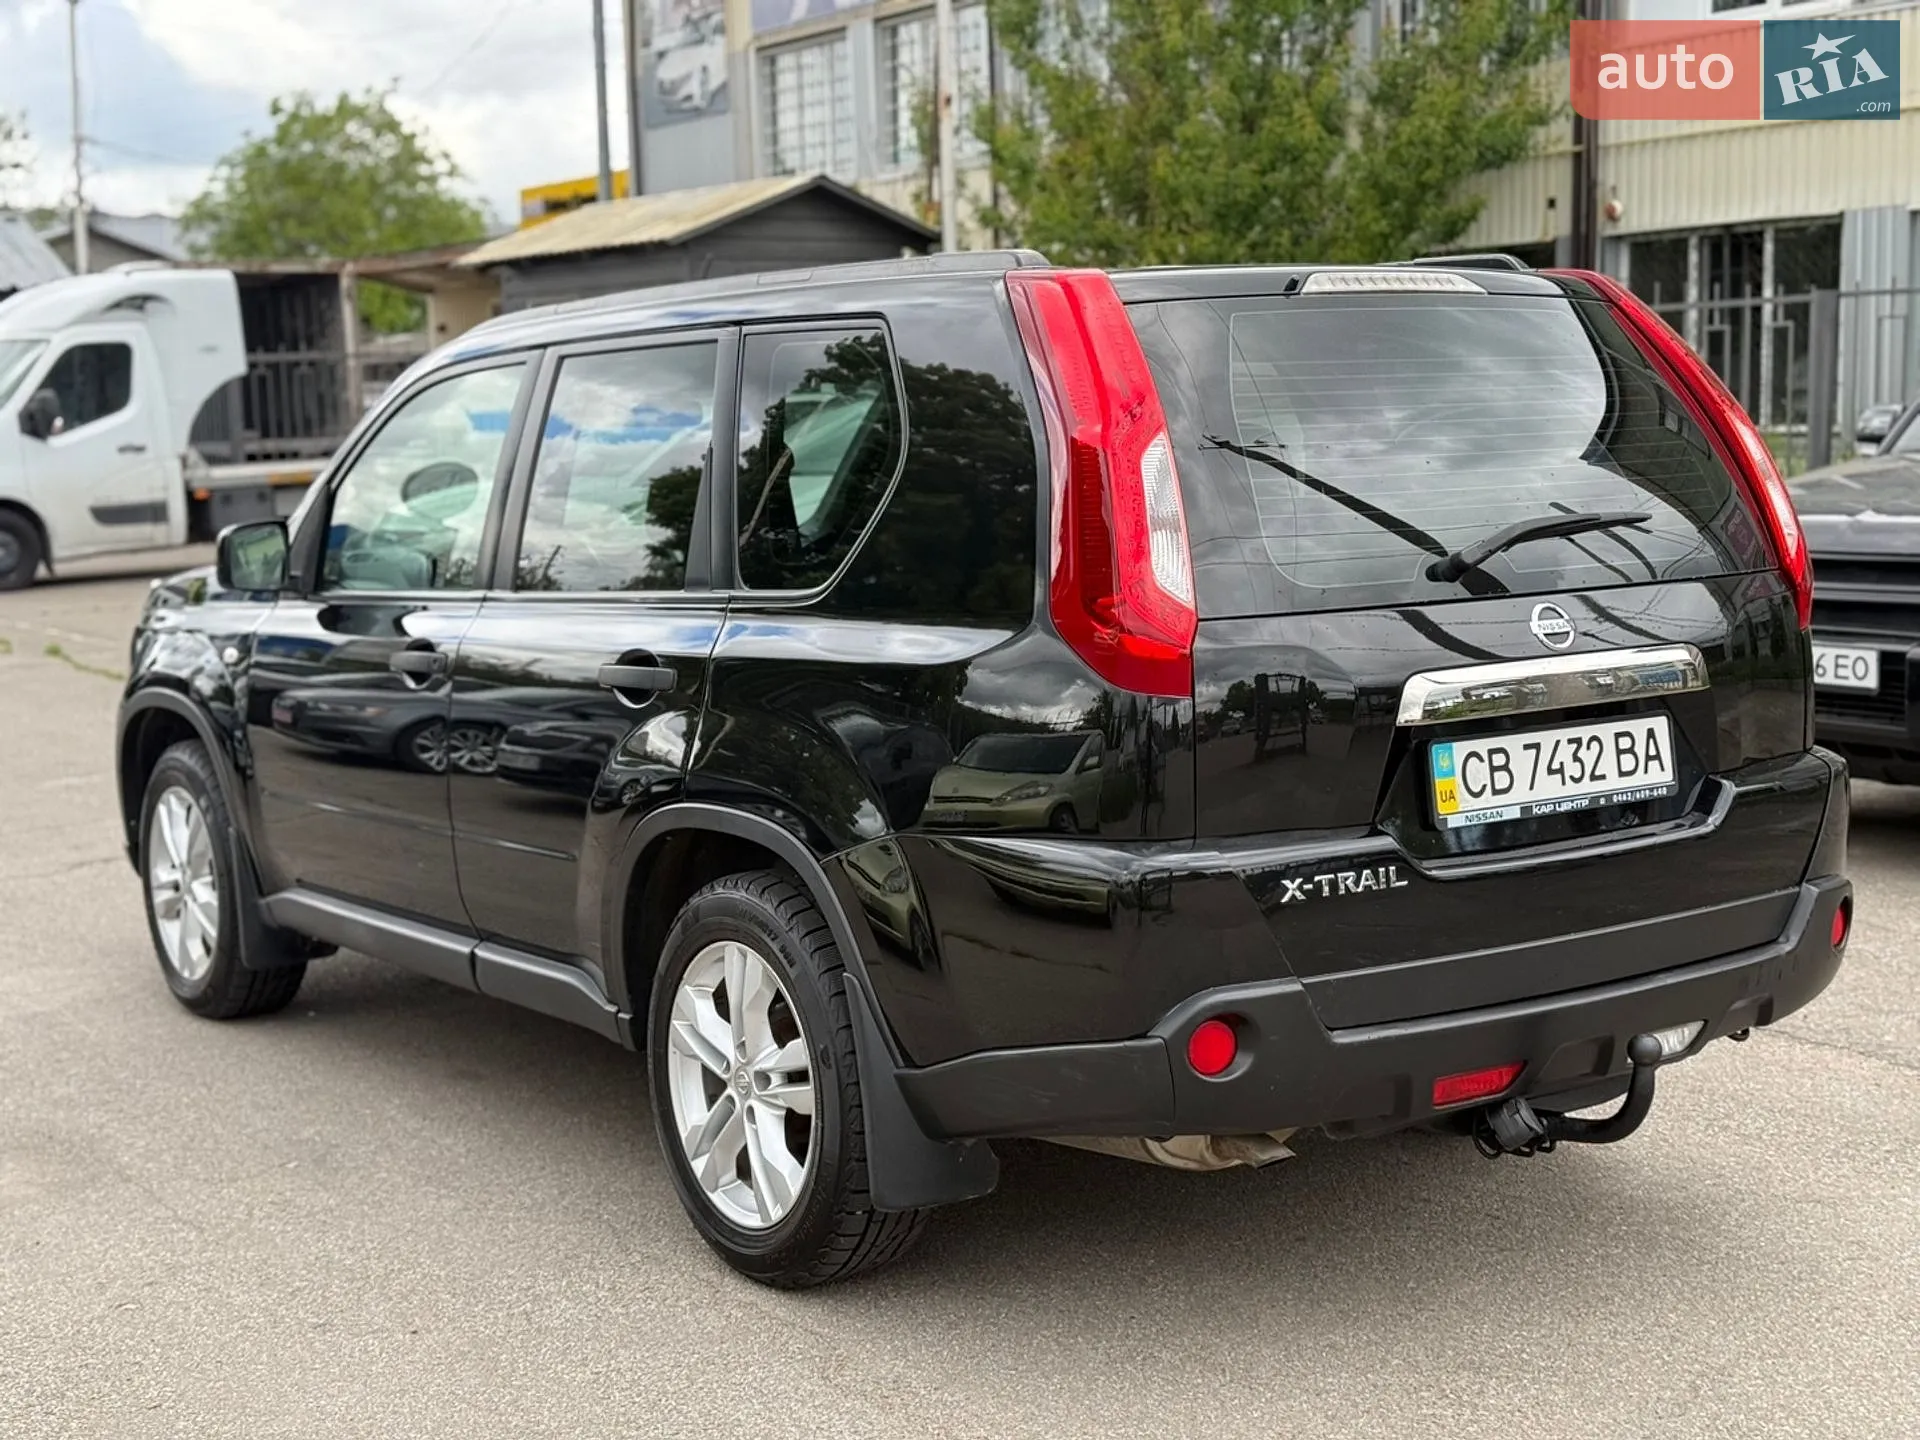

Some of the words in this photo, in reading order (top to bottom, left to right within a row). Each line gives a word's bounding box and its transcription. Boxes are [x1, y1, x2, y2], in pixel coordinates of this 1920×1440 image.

[1461, 746, 1515, 799] CB
[1522, 734, 1607, 792] 7432
[1613, 727, 1665, 778] BA
[1439, 789, 1456, 804] UA
[1464, 809, 1504, 824] NISSAN
[1532, 802, 1555, 815] КАР
[1555, 799, 1590, 813] ЦЕНТР
[1280, 866, 1409, 903] X-TRAIL
